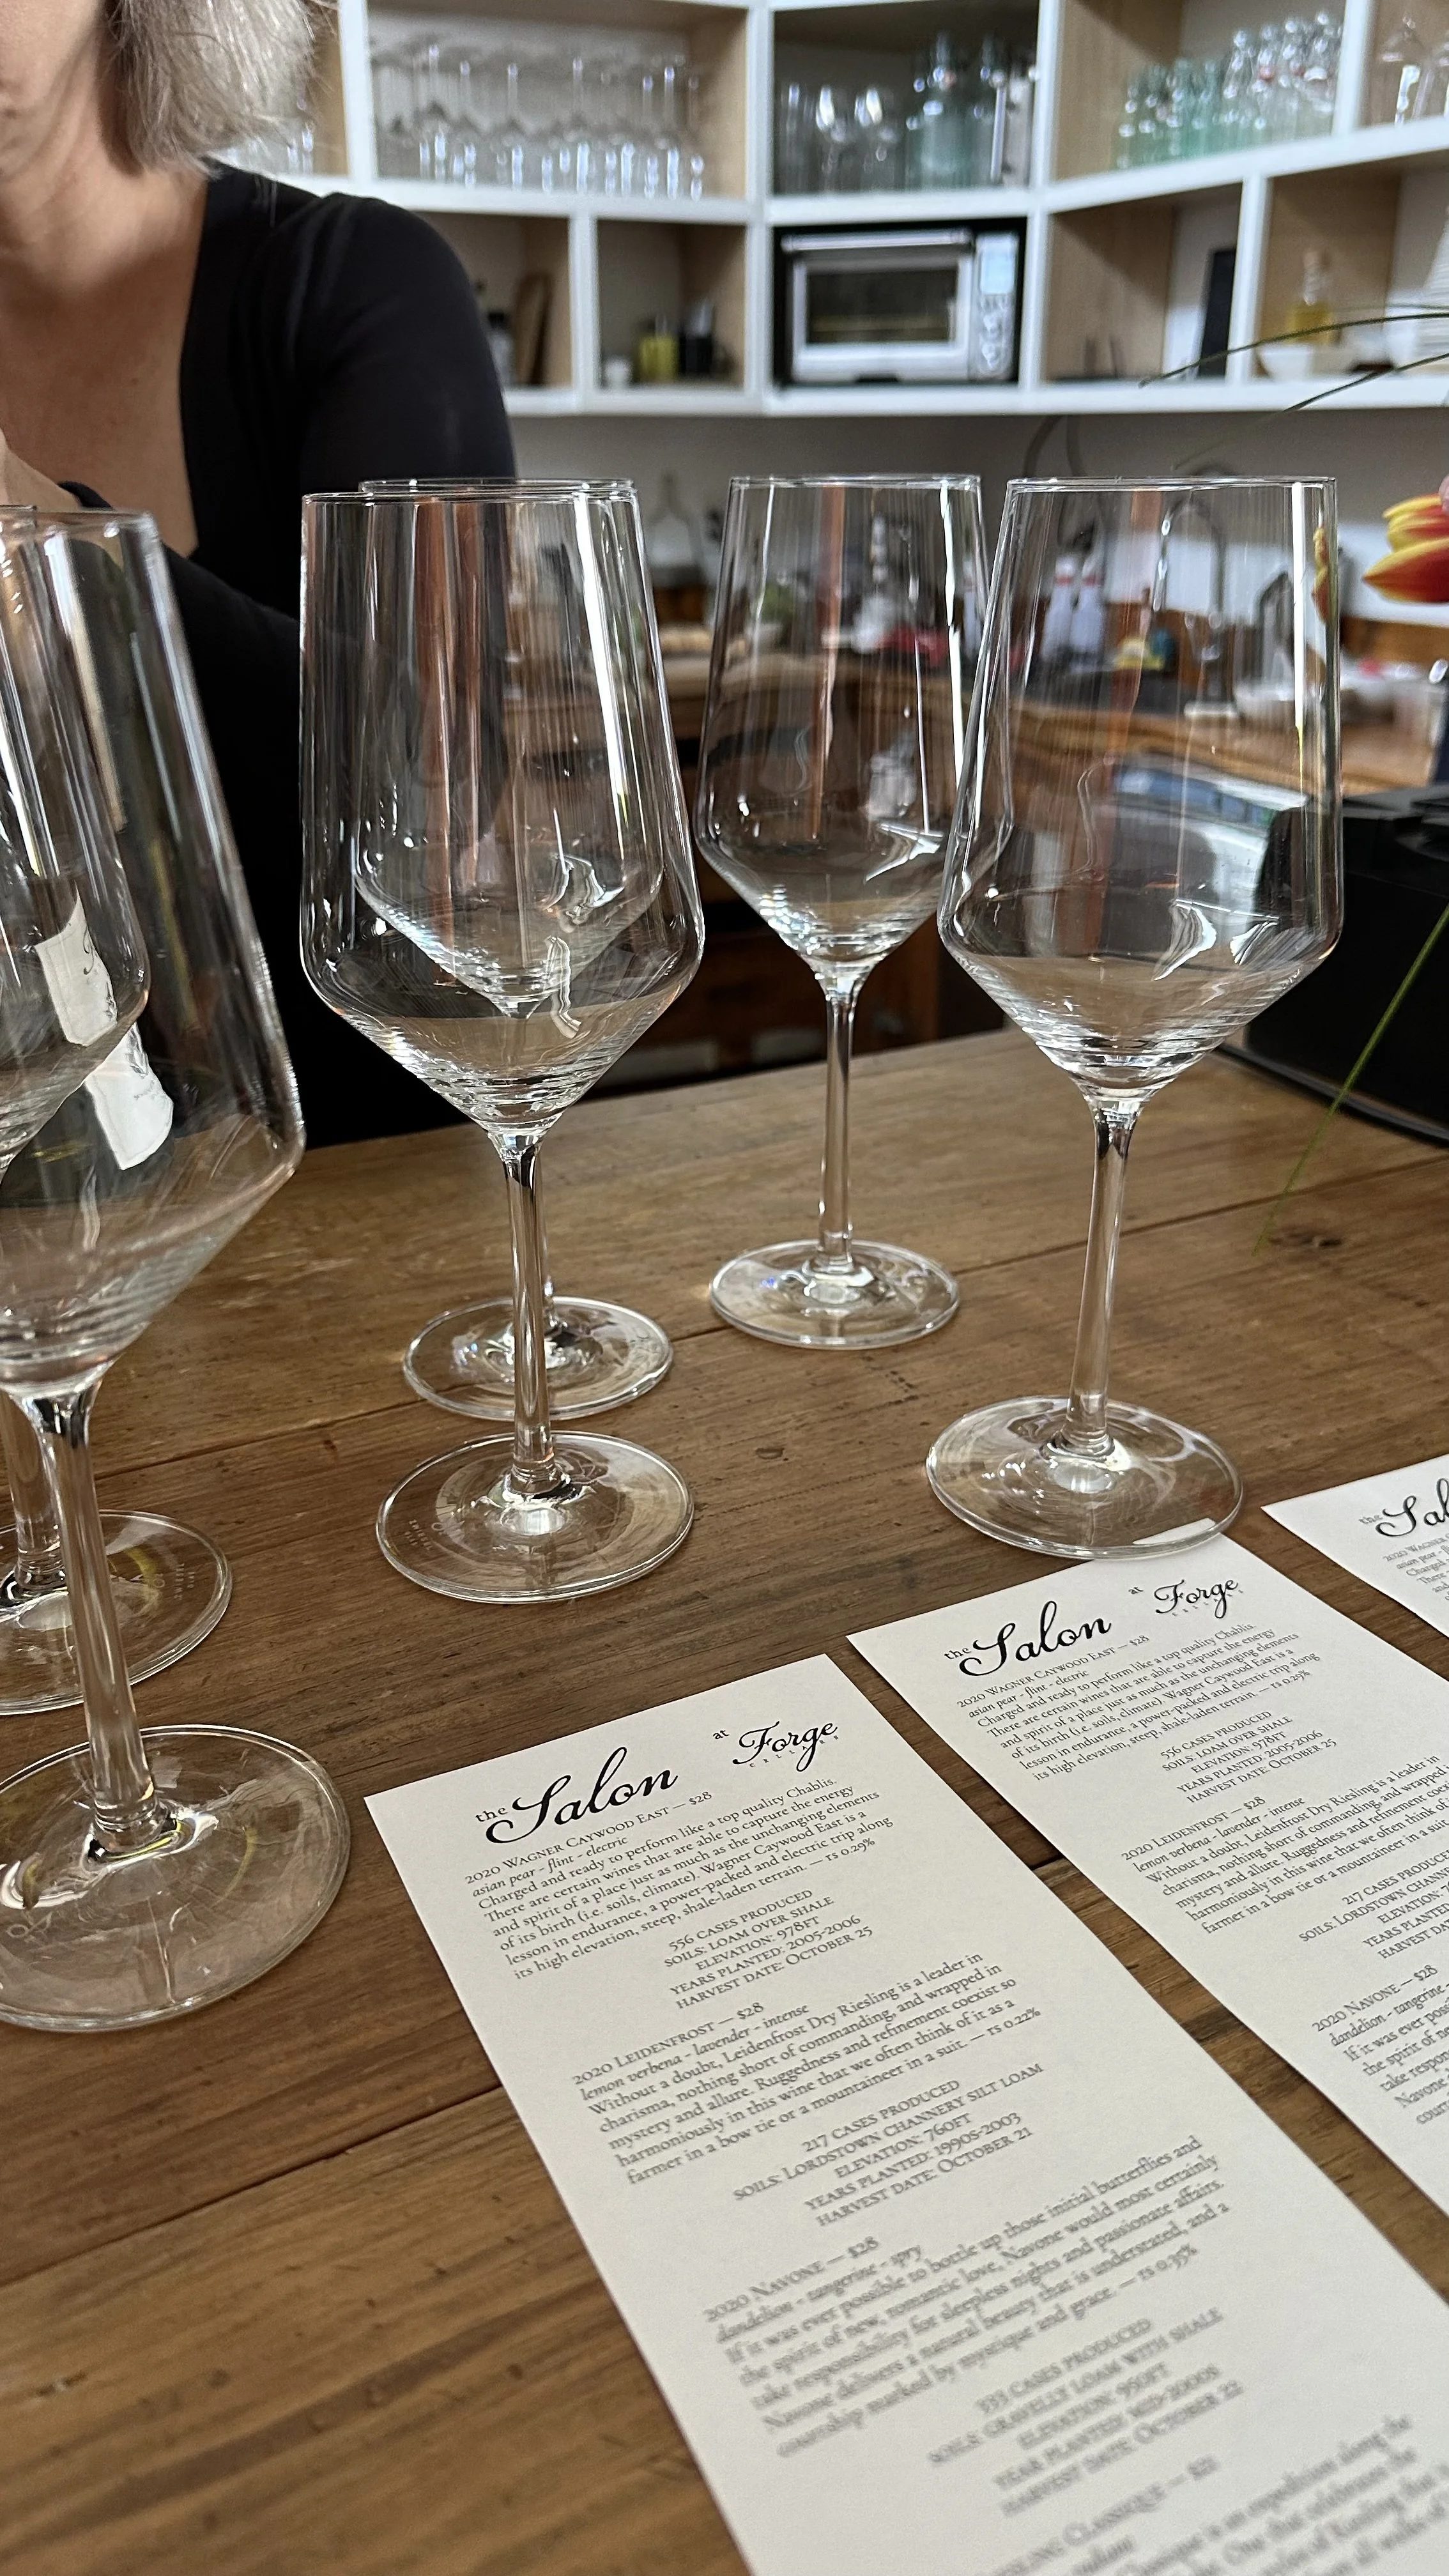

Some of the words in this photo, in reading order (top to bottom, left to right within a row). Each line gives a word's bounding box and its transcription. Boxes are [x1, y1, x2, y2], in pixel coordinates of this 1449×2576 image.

[944, 1645, 972, 1660] the
[959, 1601, 1112, 1676] Salon
[1128, 1586, 1144, 1595] at
[1153, 1579, 1239, 1619] Forge
[712, 1729, 730, 1740] at
[969, 1704, 995, 1718] asian
[995, 1695, 1017, 1710] pear
[1023, 1684, 1048, 1699] flint
[1055, 1670, 1089, 1685] electric
[732, 1721, 838, 1772] Forge
[1160, 1745, 1182, 1759] 556
[1181, 1733, 1215, 1750] CASES
[1214, 1711, 1272, 1737] PRODUCED
[475, 1807, 508, 1823] the
[486, 1747, 678, 1844] Salon
[1121, 1843, 1154, 1860] 2020
[1243, 1796, 1266, 1810] $28
[1132, 1855, 1170, 1873] lemon
[1168, 1837, 1212, 1858] verbena
[1215, 1815, 1261, 1837] lavender
[1267, 1798, 1306, 1816] intense
[464, 1866, 501, 1884] 2020
[688, 1791, 712, 1805] $28
[472, 1880, 506, 1897] asian
[509, 1869, 535, 1887] pear
[548, 1855, 574, 1873] flint
[585, 1837, 628, 1857] electric
[478, 1880, 539, 1909] Charged
[540, 1870, 567, 1887] and
[568, 1859, 604, 1877] ready
[608, 1854, 623, 1864] to
[624, 1834, 679, 1860] perform
[678, 1825, 705, 1837] like
[717, 1812, 739, 1824] top
[742, 1795, 784, 1816] quality
[786, 1779, 837, 1798] Chablis.
[484, 1904, 525, 1922] There
[528, 1895, 550, 1907] are
[553, 1877, 601, 1898] certain
[602, 1862, 641, 1880] wines
[643, 1851, 671, 1866] that
[673, 1843, 694, 1855] are
[696, 1832, 724, 1846] able
[724, 1827, 740, 1836] to
[742, 1809, 790, 1829] capture
[790, 1800, 812, 1812] the
[813, 1786, 854, 1804] energy
[493, 1918, 520, 1936] and
[523, 1906, 561, 1927] spirit
[563, 1896, 578, 1910] of
[591, 1883, 627, 1904] place
[627, 1873, 656, 1889] just
[657, 1867, 671, 1876] as
[673, 1850, 710, 1870] much
[712, 1846, 726, 1856] as
[727, 1837, 750, 1850] the
[751, 1811, 827, 1841] unchanging
[826, 1792, 880, 1814] elements
[500, 1935, 515, 1951] of
[517, 1932, 537, 1944] its
[535, 1915, 576, 1936] birth
[577, 1909, 604, 1922] (i.e.
[606, 1894, 641, 1912] soils,
[642, 1870, 700, 1897] climate).
[699, 1851, 751, 1874] Wagner
[753, 1826, 815, 1855] Caywood
[813, 1819, 844, 1833] East
[844, 1814, 856, 1823] is
[505, 1944, 551, 1965] lesson
[552, 1938, 569, 1948] in
[571, 1910, 648, 1941] endurance,
[659, 1865, 753, 1911] power-packed
[754, 1855, 780, 1871] and
[781, 1840, 829, 1861] electric
[829, 1830, 855, 1843] trip
[856, 1818, 893, 1834] along
[514, 1967, 533, 1979] its
[533, 1952, 569, 1971] high
[571, 1929, 640, 1958] elevation,
[640, 1913, 681, 1931] steep,
[682, 1882, 757, 1915] shale-laden
[758, 1865, 807, 1885] terrain.
[840, 1837, 875, 1855] 0.29%
[668, 1934, 694, 1952] 556
[696, 1918, 739, 1939] CASES
[739, 1890, 813, 1922] PRODUCED
[664, 1946, 707, 1967] SOILS:
[707, 1929, 750, 1951] LOAM
[751, 1914, 790, 1933] OVER
[789, 1896, 834, 1918] SHALE
[670, 1972, 716, 1995] YEARS
[716, 1946, 786, 1977] PLANTED:
[785, 1914, 861, 1950] 2005-2006
[675, 1977, 740, 2009] HARVEST
[742, 1962, 785, 1982] DATE:
[854, 1926, 873, 1938] 25
[694, 1935, 776, 1970] ELEVATION:
[776, 1915, 820, 1940] 978FT
[572, 2063, 613, 2085] 2020
[736, 2002, 764, 2020] $28
[579, 2078, 625, 2101] lemon
[626, 2055, 683, 2082] verbena
[691, 2027, 750, 2056] lavender
[762, 2005, 809, 2028] intense
[801, 2134, 828, 2152] 217
[831, 2113, 878, 2140] CASES
[878, 2080, 960, 2120] PRODUCED
